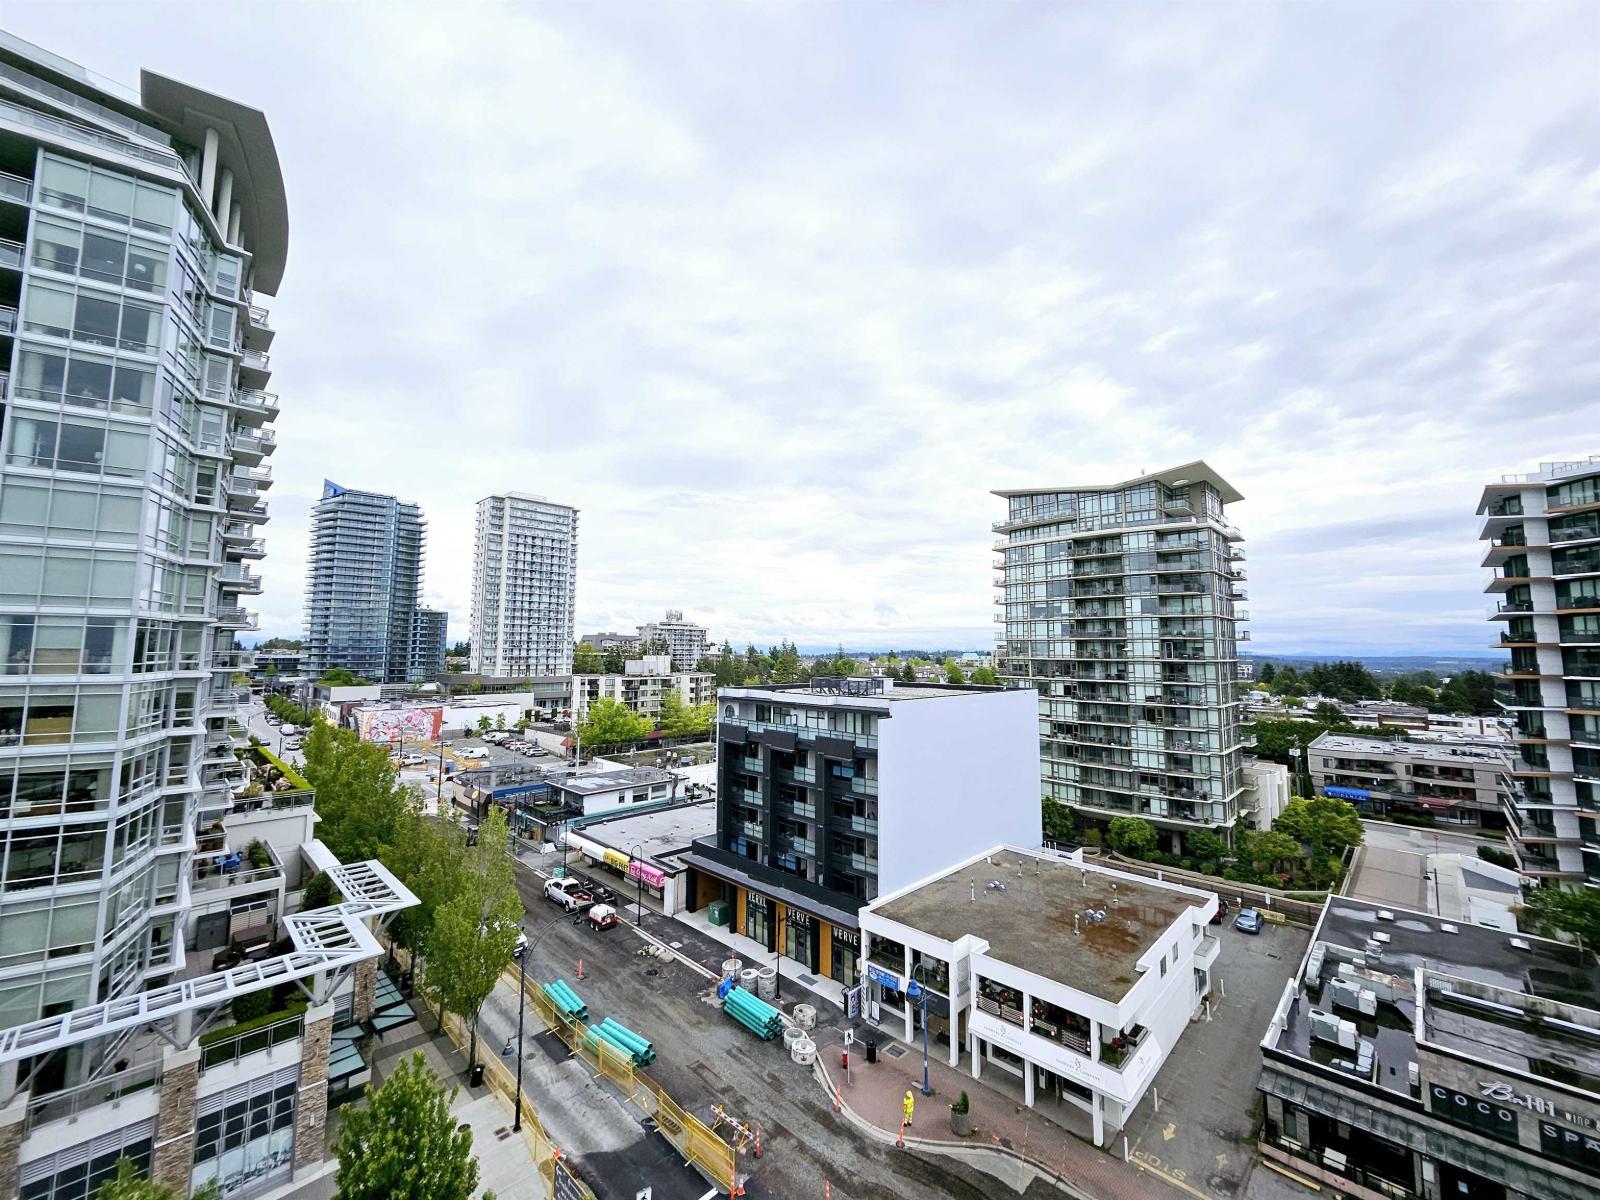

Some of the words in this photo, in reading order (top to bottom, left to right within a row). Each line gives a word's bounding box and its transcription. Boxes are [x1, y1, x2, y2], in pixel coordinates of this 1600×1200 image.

[748, 892, 768, 908] VERVE
[787, 907, 810, 926] VERVE
[833, 927, 858, 946] VERVE
[1434, 1087, 1512, 1121] COCO
[1543, 1124, 1600, 1153] SPA
[1135, 1151, 1187, 1181] STOP
